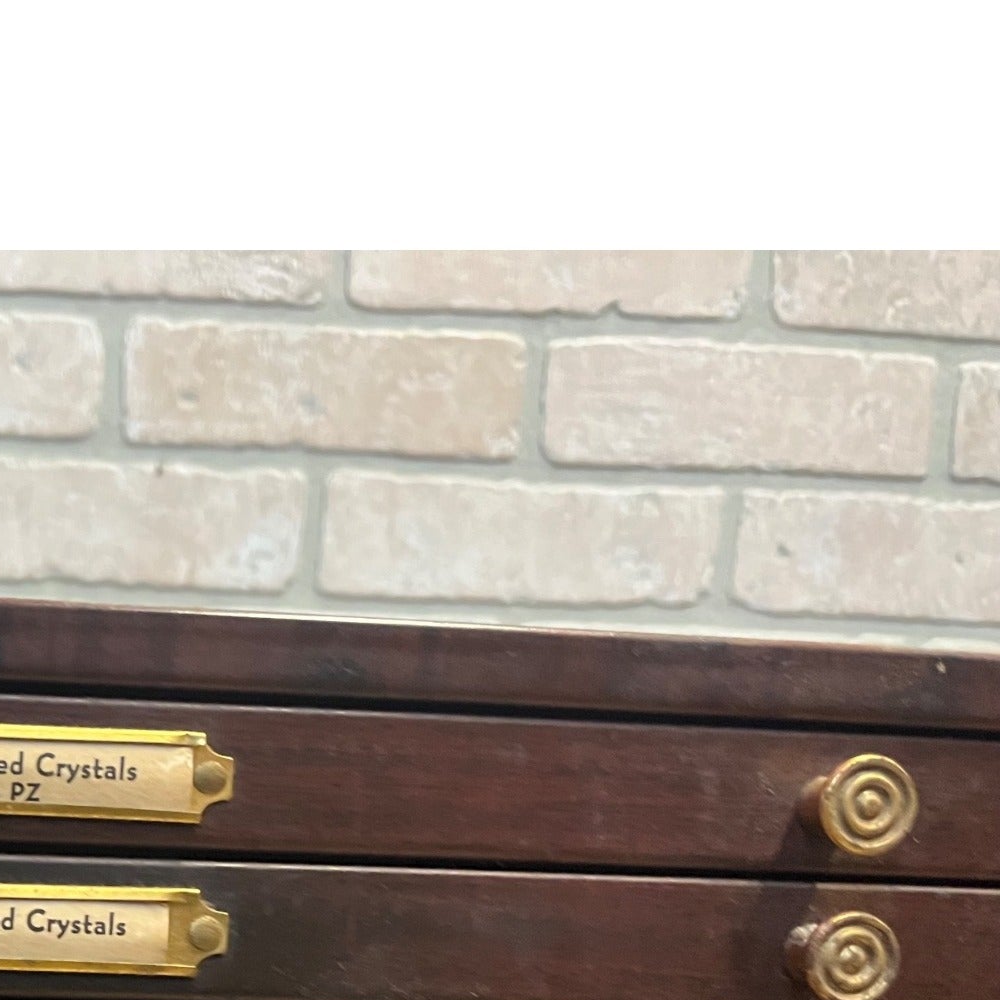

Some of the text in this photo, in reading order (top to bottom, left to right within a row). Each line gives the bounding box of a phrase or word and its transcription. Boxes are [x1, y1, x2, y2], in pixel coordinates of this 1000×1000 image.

[36, 752, 138, 784] Crystals
[10, 782, 41, 802] PZ
[27, 909, 127, 939] Crystals
